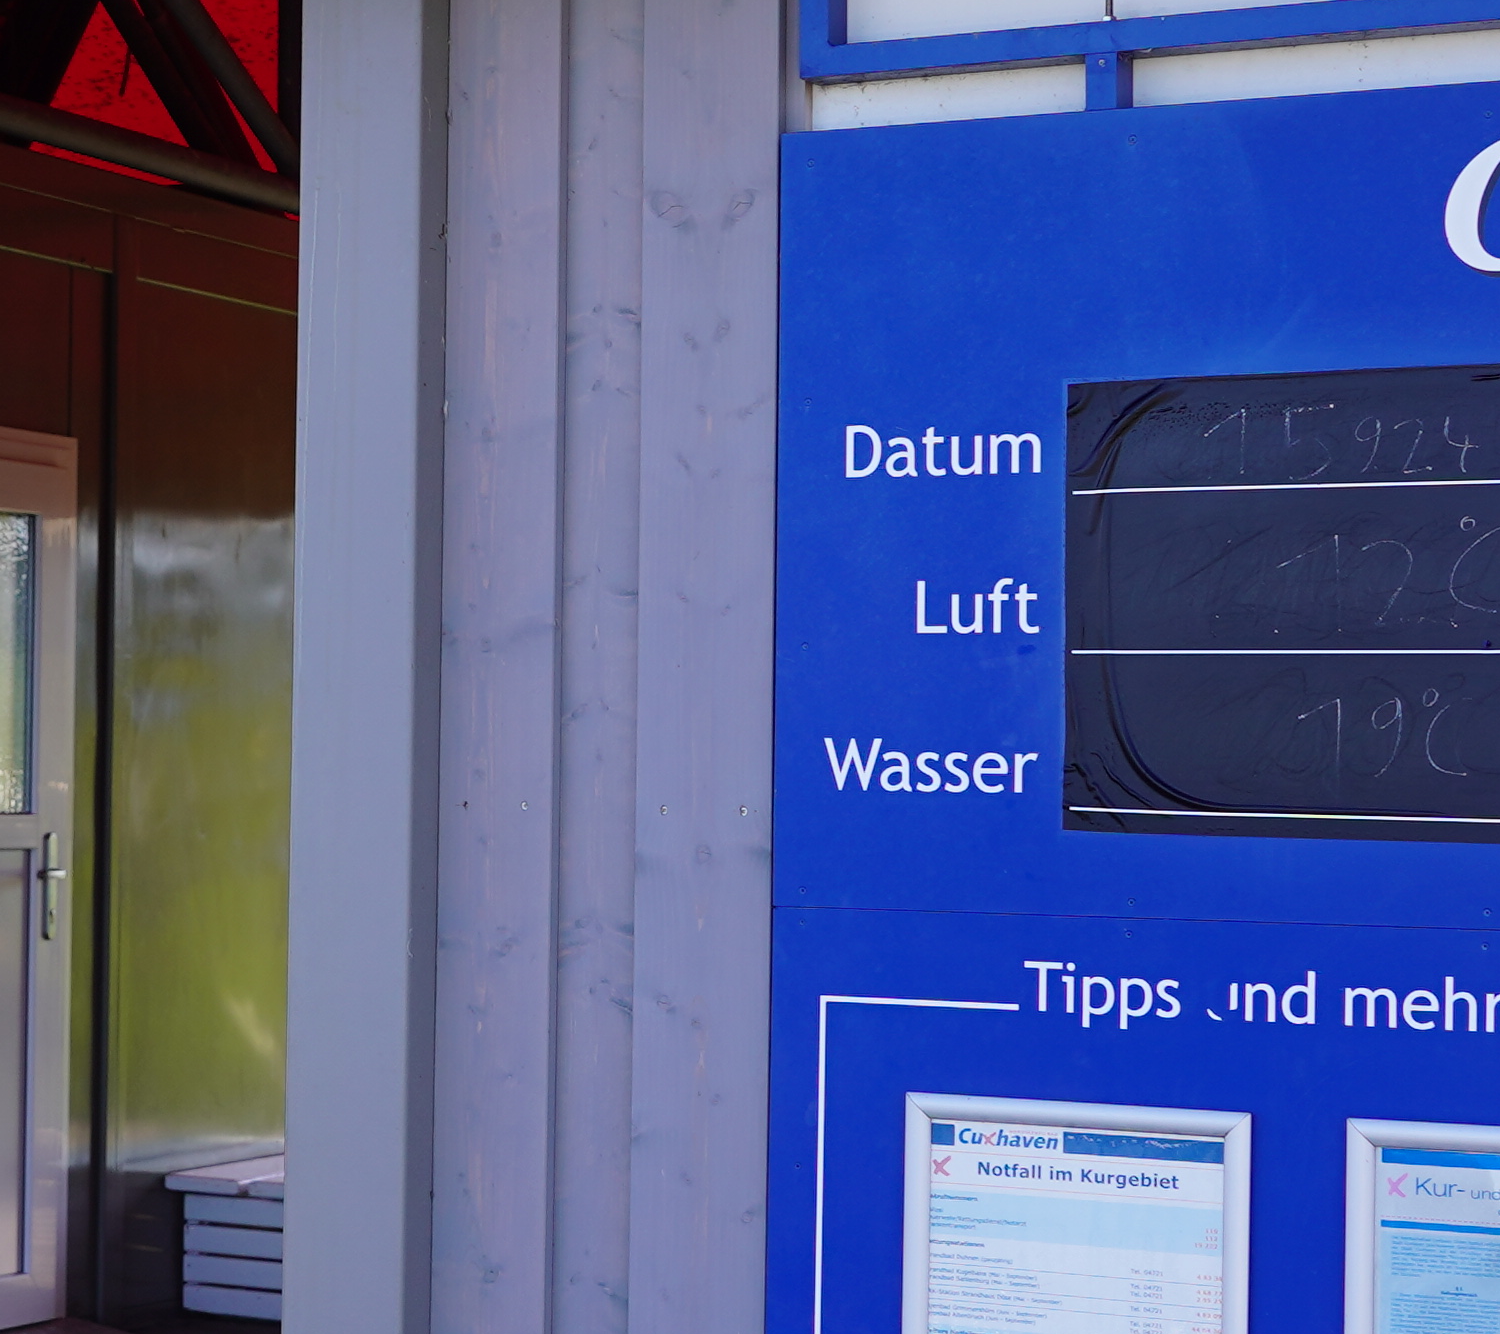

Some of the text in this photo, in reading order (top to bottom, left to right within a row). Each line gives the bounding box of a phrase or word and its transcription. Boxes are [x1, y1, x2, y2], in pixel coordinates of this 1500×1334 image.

[845, 424, 1042, 478] Datum
[916, 577, 1040, 635] Luft
[823, 737, 1039, 794] Wasser
[1024, 961, 1181, 1029] Tipps
[958, 1128, 1059, 1150] Cuxhaven
[977, 1161, 1180, 1190] Notfall im Kurgebiet
[1415, 1177, 1465, 1198] Kur-
